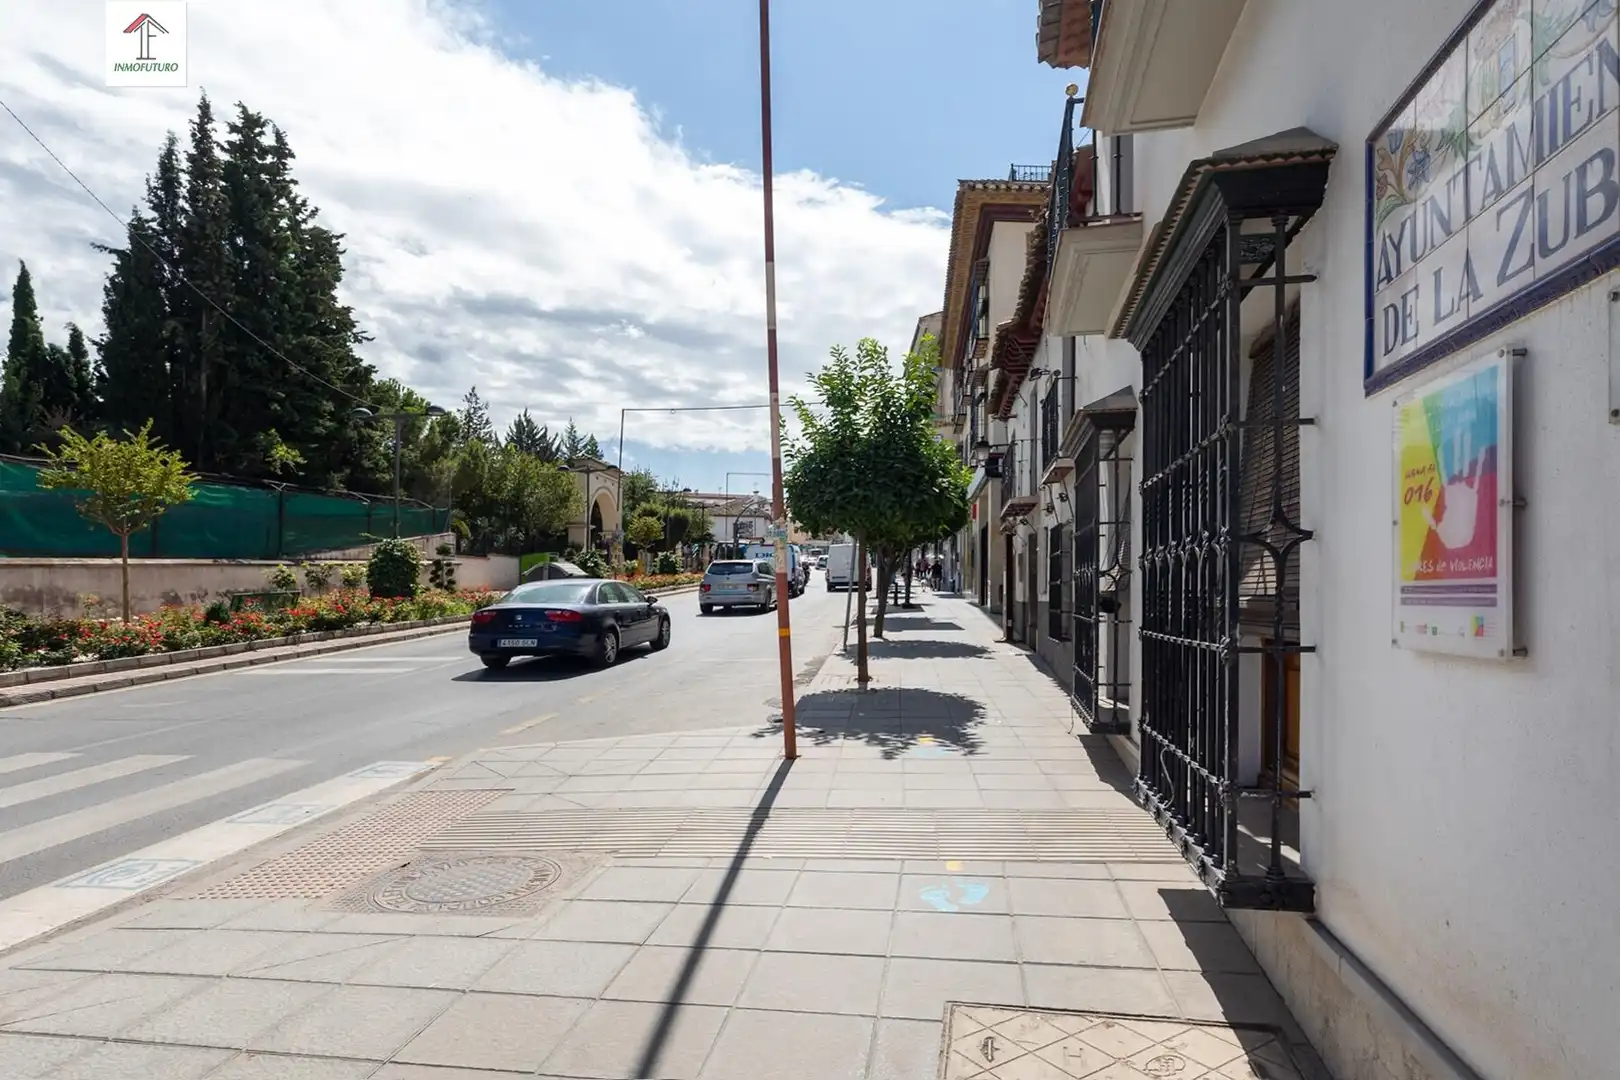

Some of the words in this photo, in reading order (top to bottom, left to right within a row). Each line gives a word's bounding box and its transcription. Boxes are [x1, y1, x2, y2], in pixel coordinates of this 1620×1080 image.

[1383, 283, 1419, 356] DE
[1433, 248, 1484, 326] LA
[1403, 476, 1434, 505] 016
